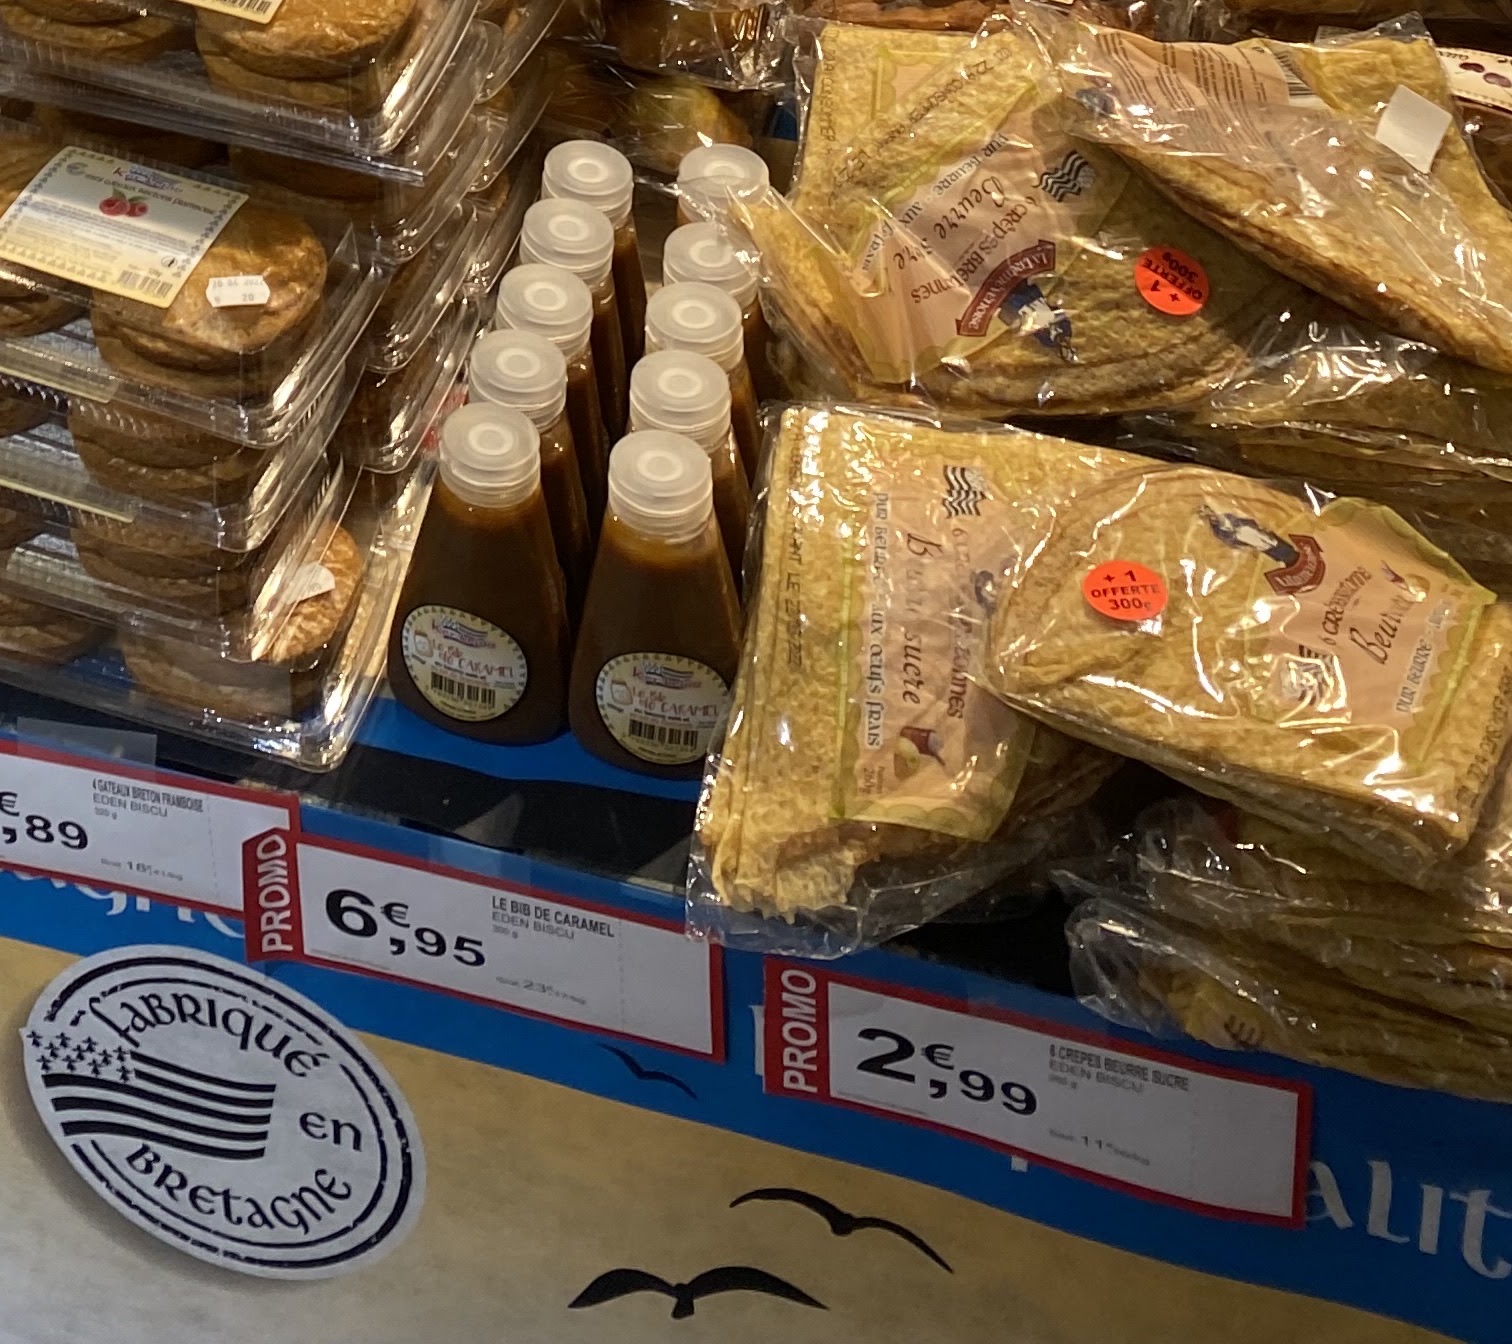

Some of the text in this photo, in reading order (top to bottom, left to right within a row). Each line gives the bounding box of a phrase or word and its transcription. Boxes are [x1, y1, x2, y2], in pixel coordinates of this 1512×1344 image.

[1089, 583, 1161, 600] OFFERTE
[92, 792, 168, 818] EDEN BISCU
[97, 778, 131, 798] GATEAUX
[131, 786, 161, 805] BRETON
[261, 831, 294, 953] PROMO
[492, 895, 615, 938] LE BIB DE CARAMEL
[492, 911, 575, 940] EDEN BISCU
[782, 969, 819, 1094] PROMO
[1151, 1069, 1189, 1092] SUCRE
